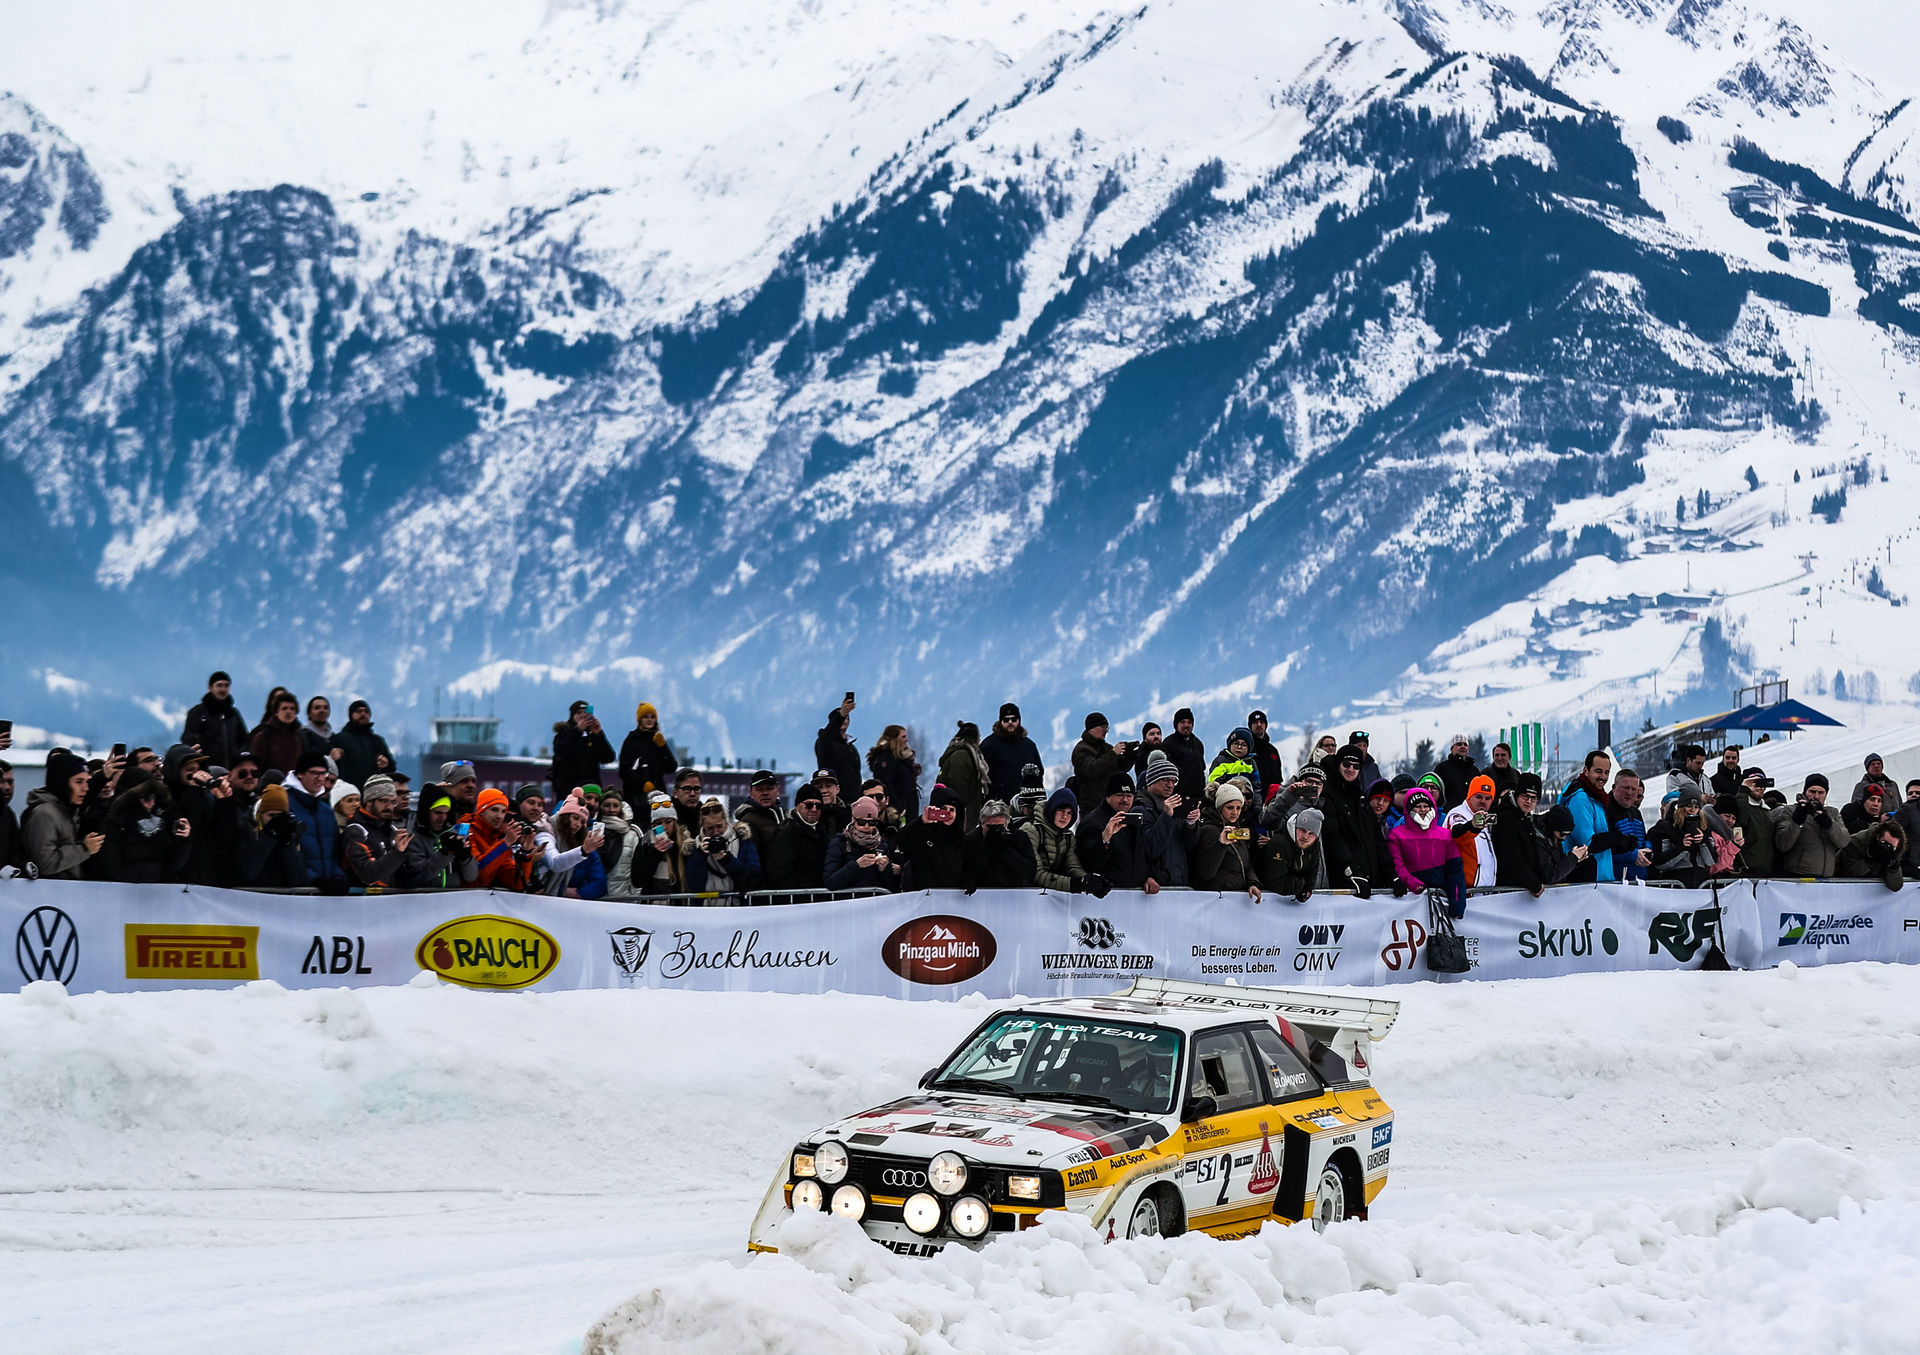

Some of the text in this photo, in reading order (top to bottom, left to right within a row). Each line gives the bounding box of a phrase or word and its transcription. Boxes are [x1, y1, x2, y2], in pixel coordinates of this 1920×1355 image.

[1517, 918, 1593, 960] skruf
[1801, 931, 1851, 949] Kaprun
[135, 935, 248, 969] PIRELLI
[300, 935, 372, 975] ABL
[453, 936, 540, 970] RAUCH
[660, 929, 839, 980] Backhausen
[899, 941, 980, 963] Pinzgau Milch
[1041, 954, 1154, 970] WIENINGER BIER
[1191, 945, 1281, 959] Die Energie für ein
[1293, 952, 1340, 972] OMV
[1046, 971, 1070, 980] Höchste
[1069, 971, 1102, 980] Braukultur
[1201, 961, 1278, 975] besseres Leben.
[1183, 995, 1217, 1004] HB
[1274, 1003, 1340, 1017] TEAM
[1002, 1019, 1036, 1029] HB
[1091, 1026, 1158, 1042] TEAM
[1273, 1072, 1307, 1089] BLOMQVIST
[1293, 1105, 1343, 1124] quattro
[1332, 1133, 1356, 1146] MICHELIN
[1373, 1125, 1391, 1144] SKF
[1109, 1152, 1148, 1170] Audi Sport
[1197, 1157, 1217, 1183] S1
[1256, 1151, 1274, 1180] HB
[1367, 1147, 1390, 1171] BOGE
[1067, 1165, 1099, 1187] Castrol
[1215, 1153, 1233, 1207] 2
[870, 1238, 945, 1258] HELIN
